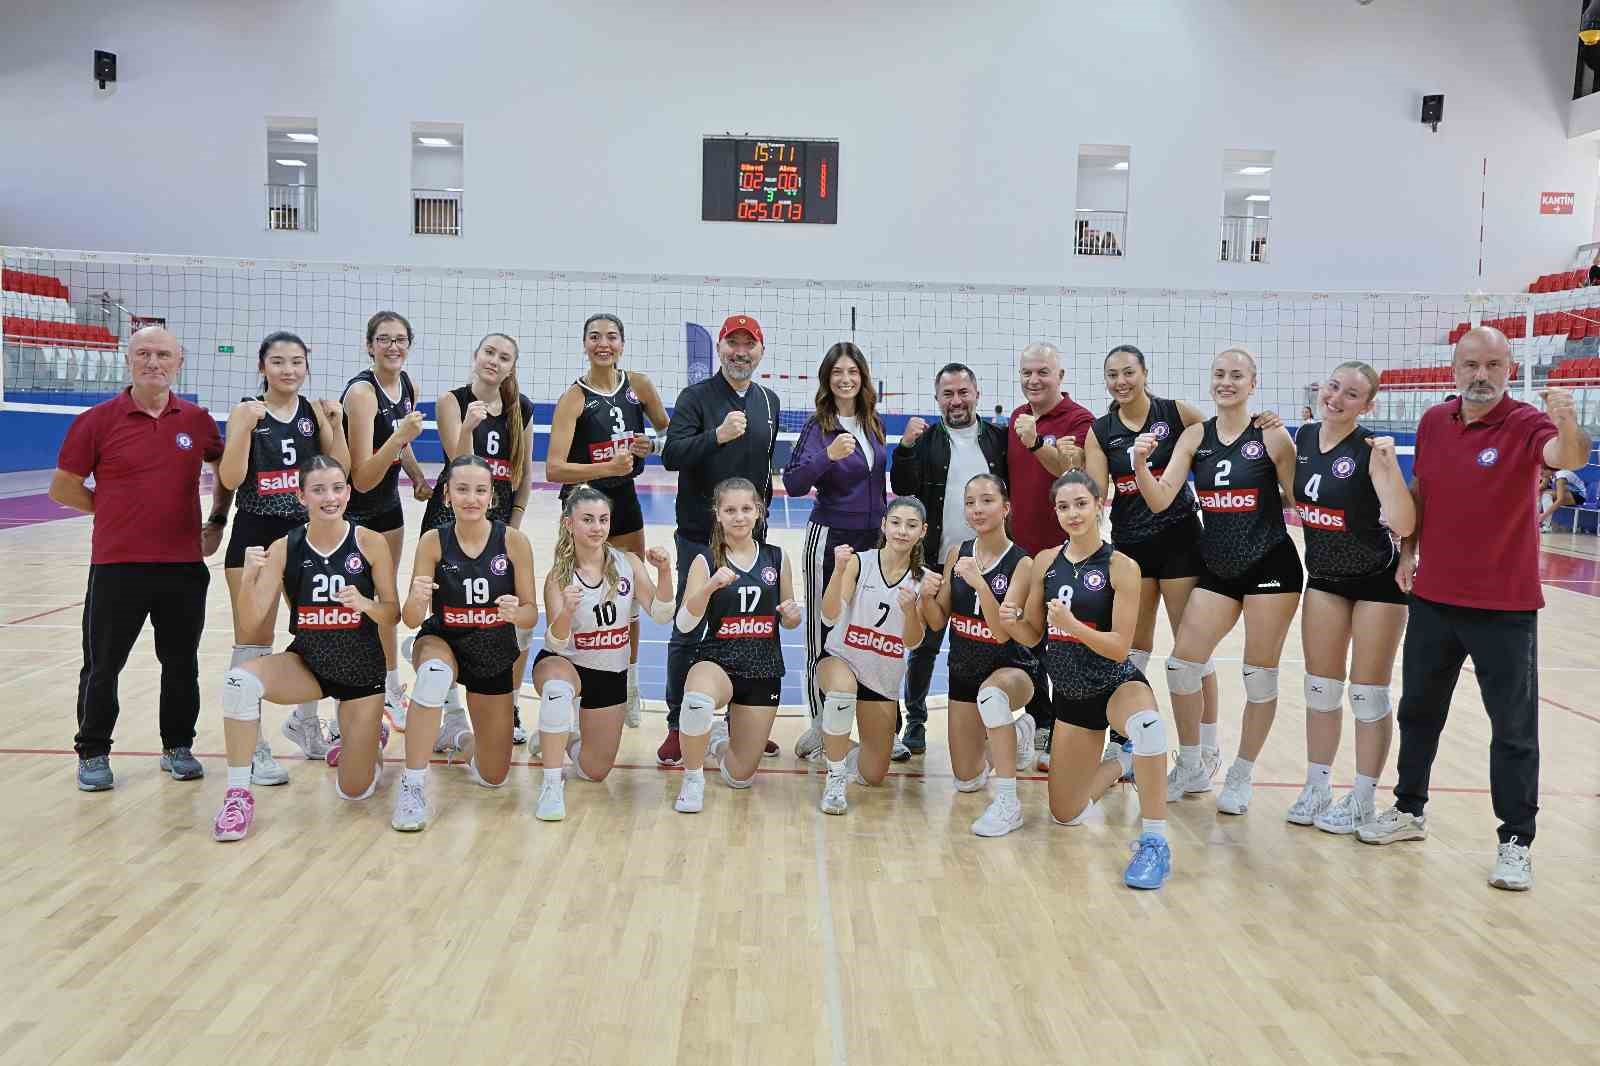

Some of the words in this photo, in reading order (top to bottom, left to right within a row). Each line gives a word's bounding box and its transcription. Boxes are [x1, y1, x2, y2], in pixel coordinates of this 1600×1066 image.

[609, 406, 626, 434] 3
[281, 438, 297, 466] 5
[486, 430, 500, 456] 6
[260, 471, 300, 491] sald
[1214, 459, 1232, 487] 2
[1304, 473, 1322, 502] 4
[312, 573, 346, 602] 20
[462, 577, 490, 605] 19
[737, 586, 762, 613] 17
[592, 600, 617, 627] 10
[718, 617, 773, 635] saldos
[874, 601, 891, 628] 7
[575, 630, 630, 648] saldos
[846, 630, 904, 655] saldos
